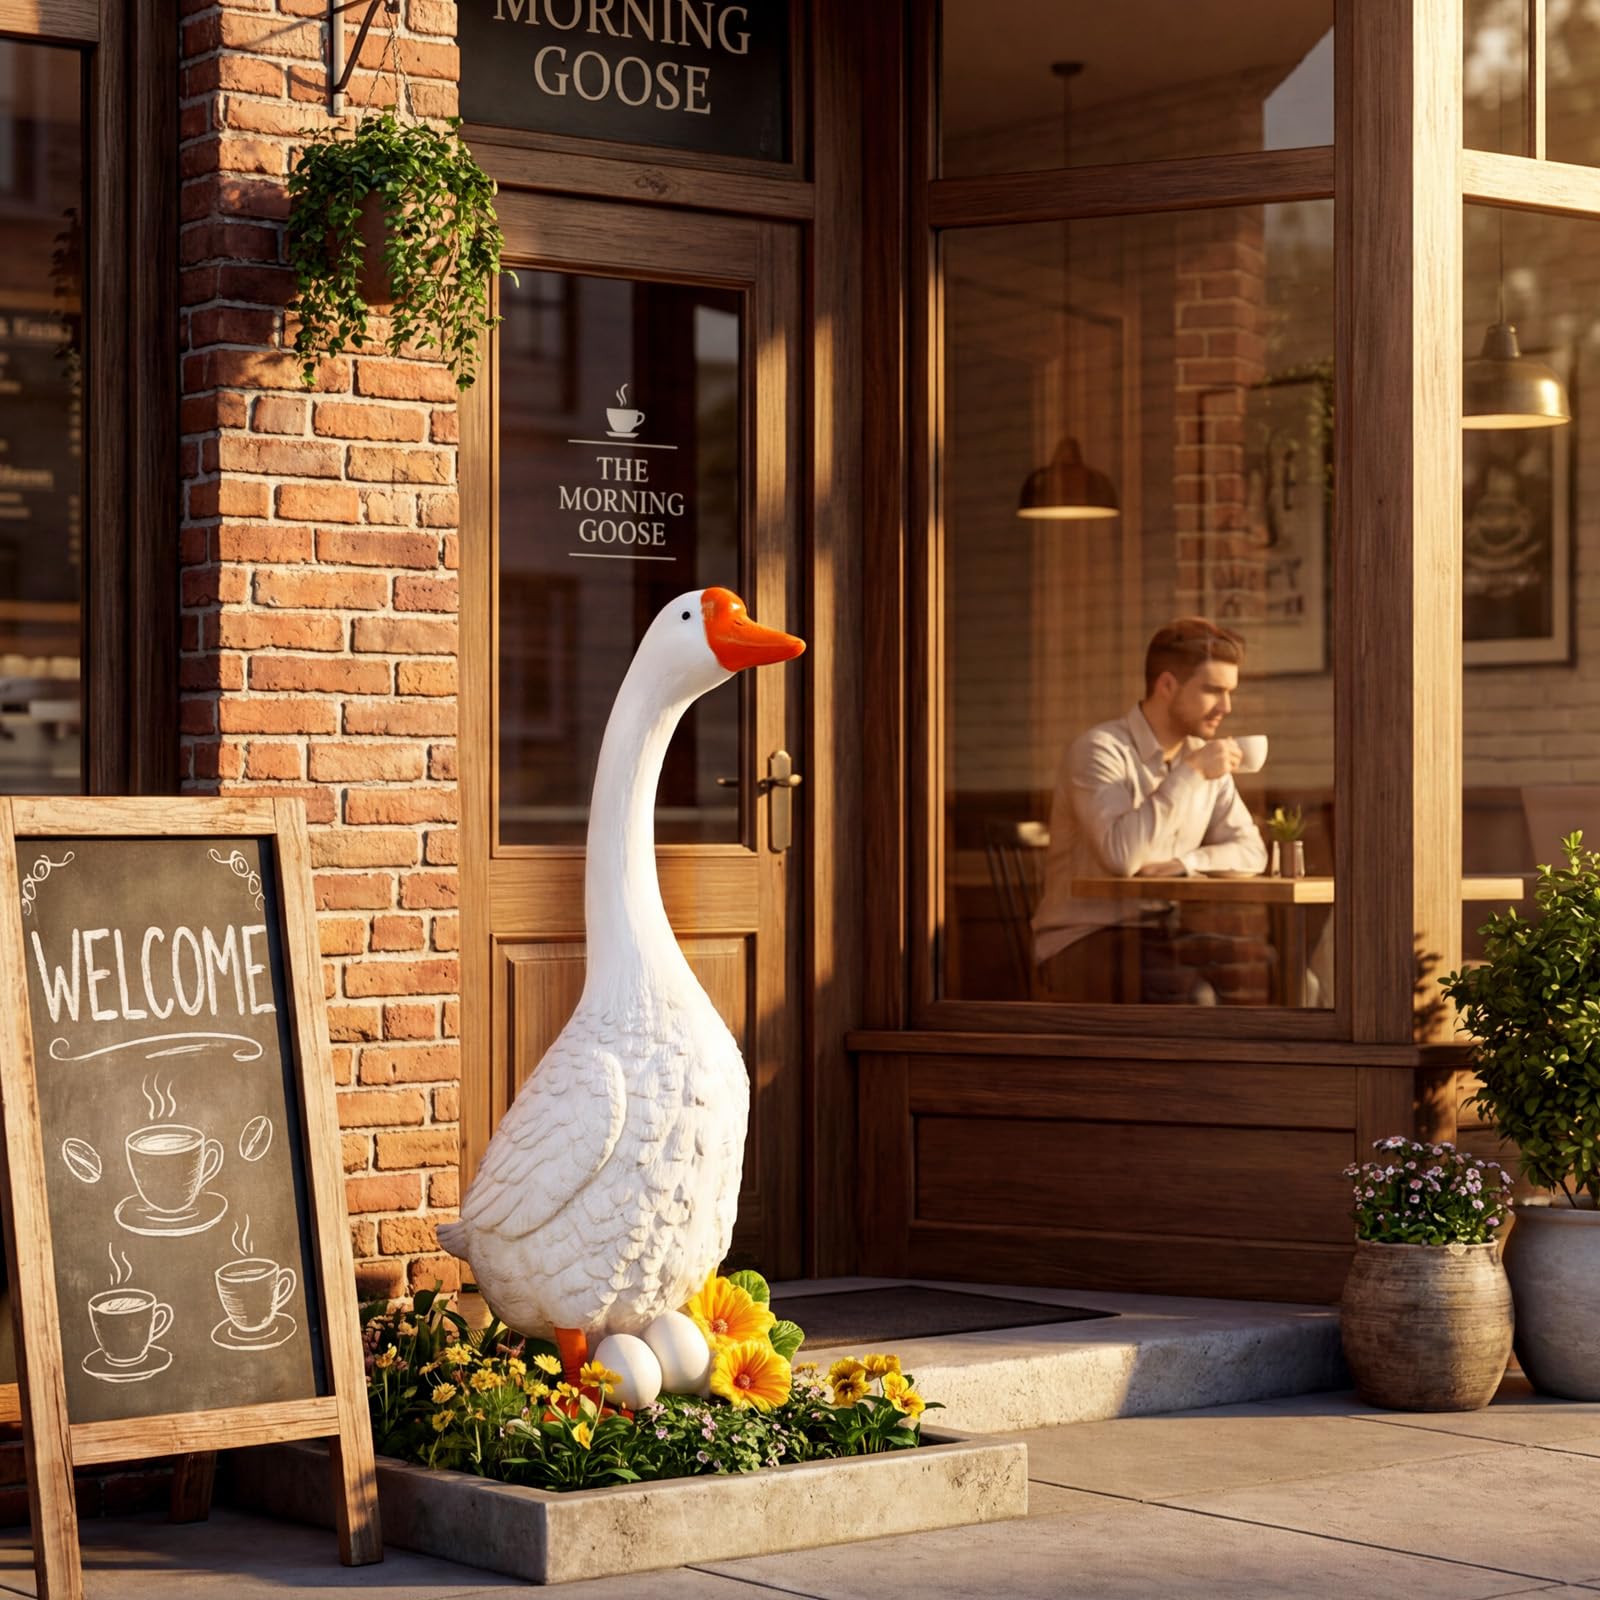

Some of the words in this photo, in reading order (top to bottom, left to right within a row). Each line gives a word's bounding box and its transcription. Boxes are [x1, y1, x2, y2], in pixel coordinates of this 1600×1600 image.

[534, 46, 711, 115] GOOSE
[596, 457, 649, 483] THE
[559, 485, 684, 516] MORNING
[579, 518, 666, 546] GOOSE
[31, 925, 277, 1024] WELCOME
